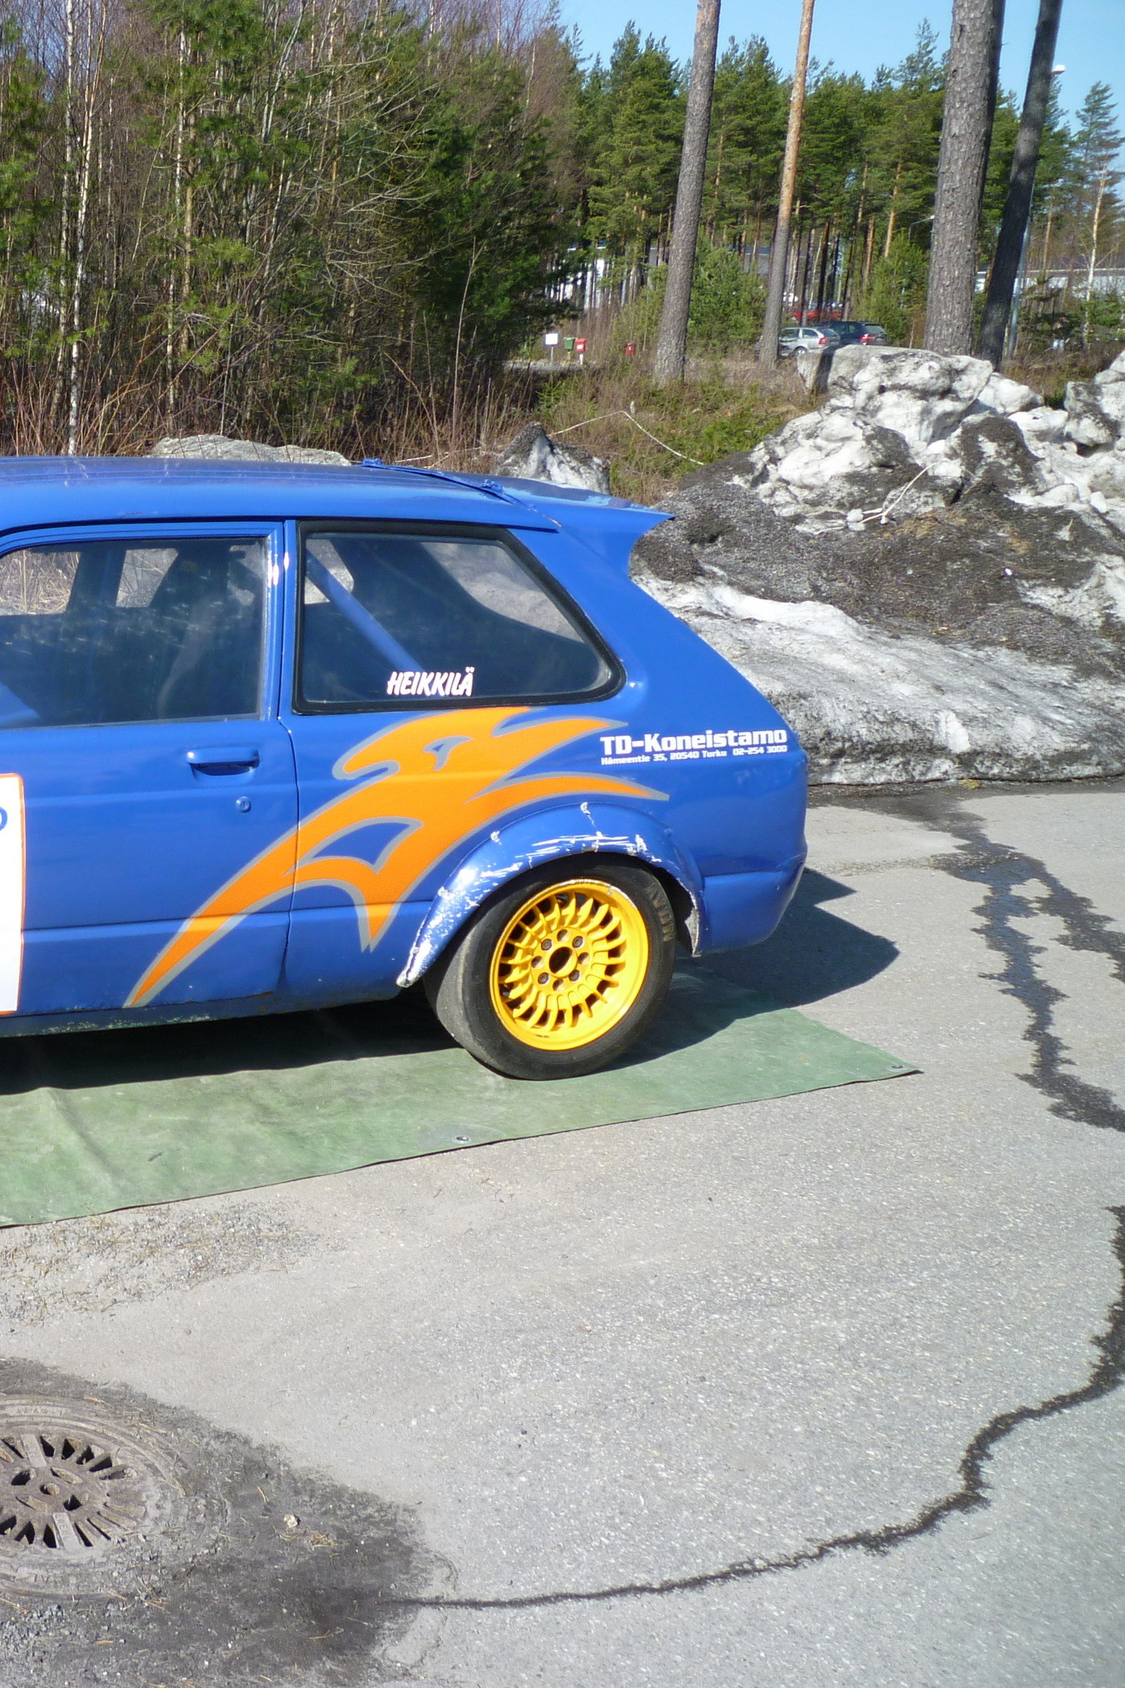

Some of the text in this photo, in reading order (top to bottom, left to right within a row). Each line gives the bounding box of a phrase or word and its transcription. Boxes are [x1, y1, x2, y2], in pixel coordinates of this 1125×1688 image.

[386, 666, 475, 696] HEIKKILÄ
[599, 729, 787, 756] TD-Koneistamo
[702, 750, 727, 758] Turku
[767, 745, 787, 753] 3000
